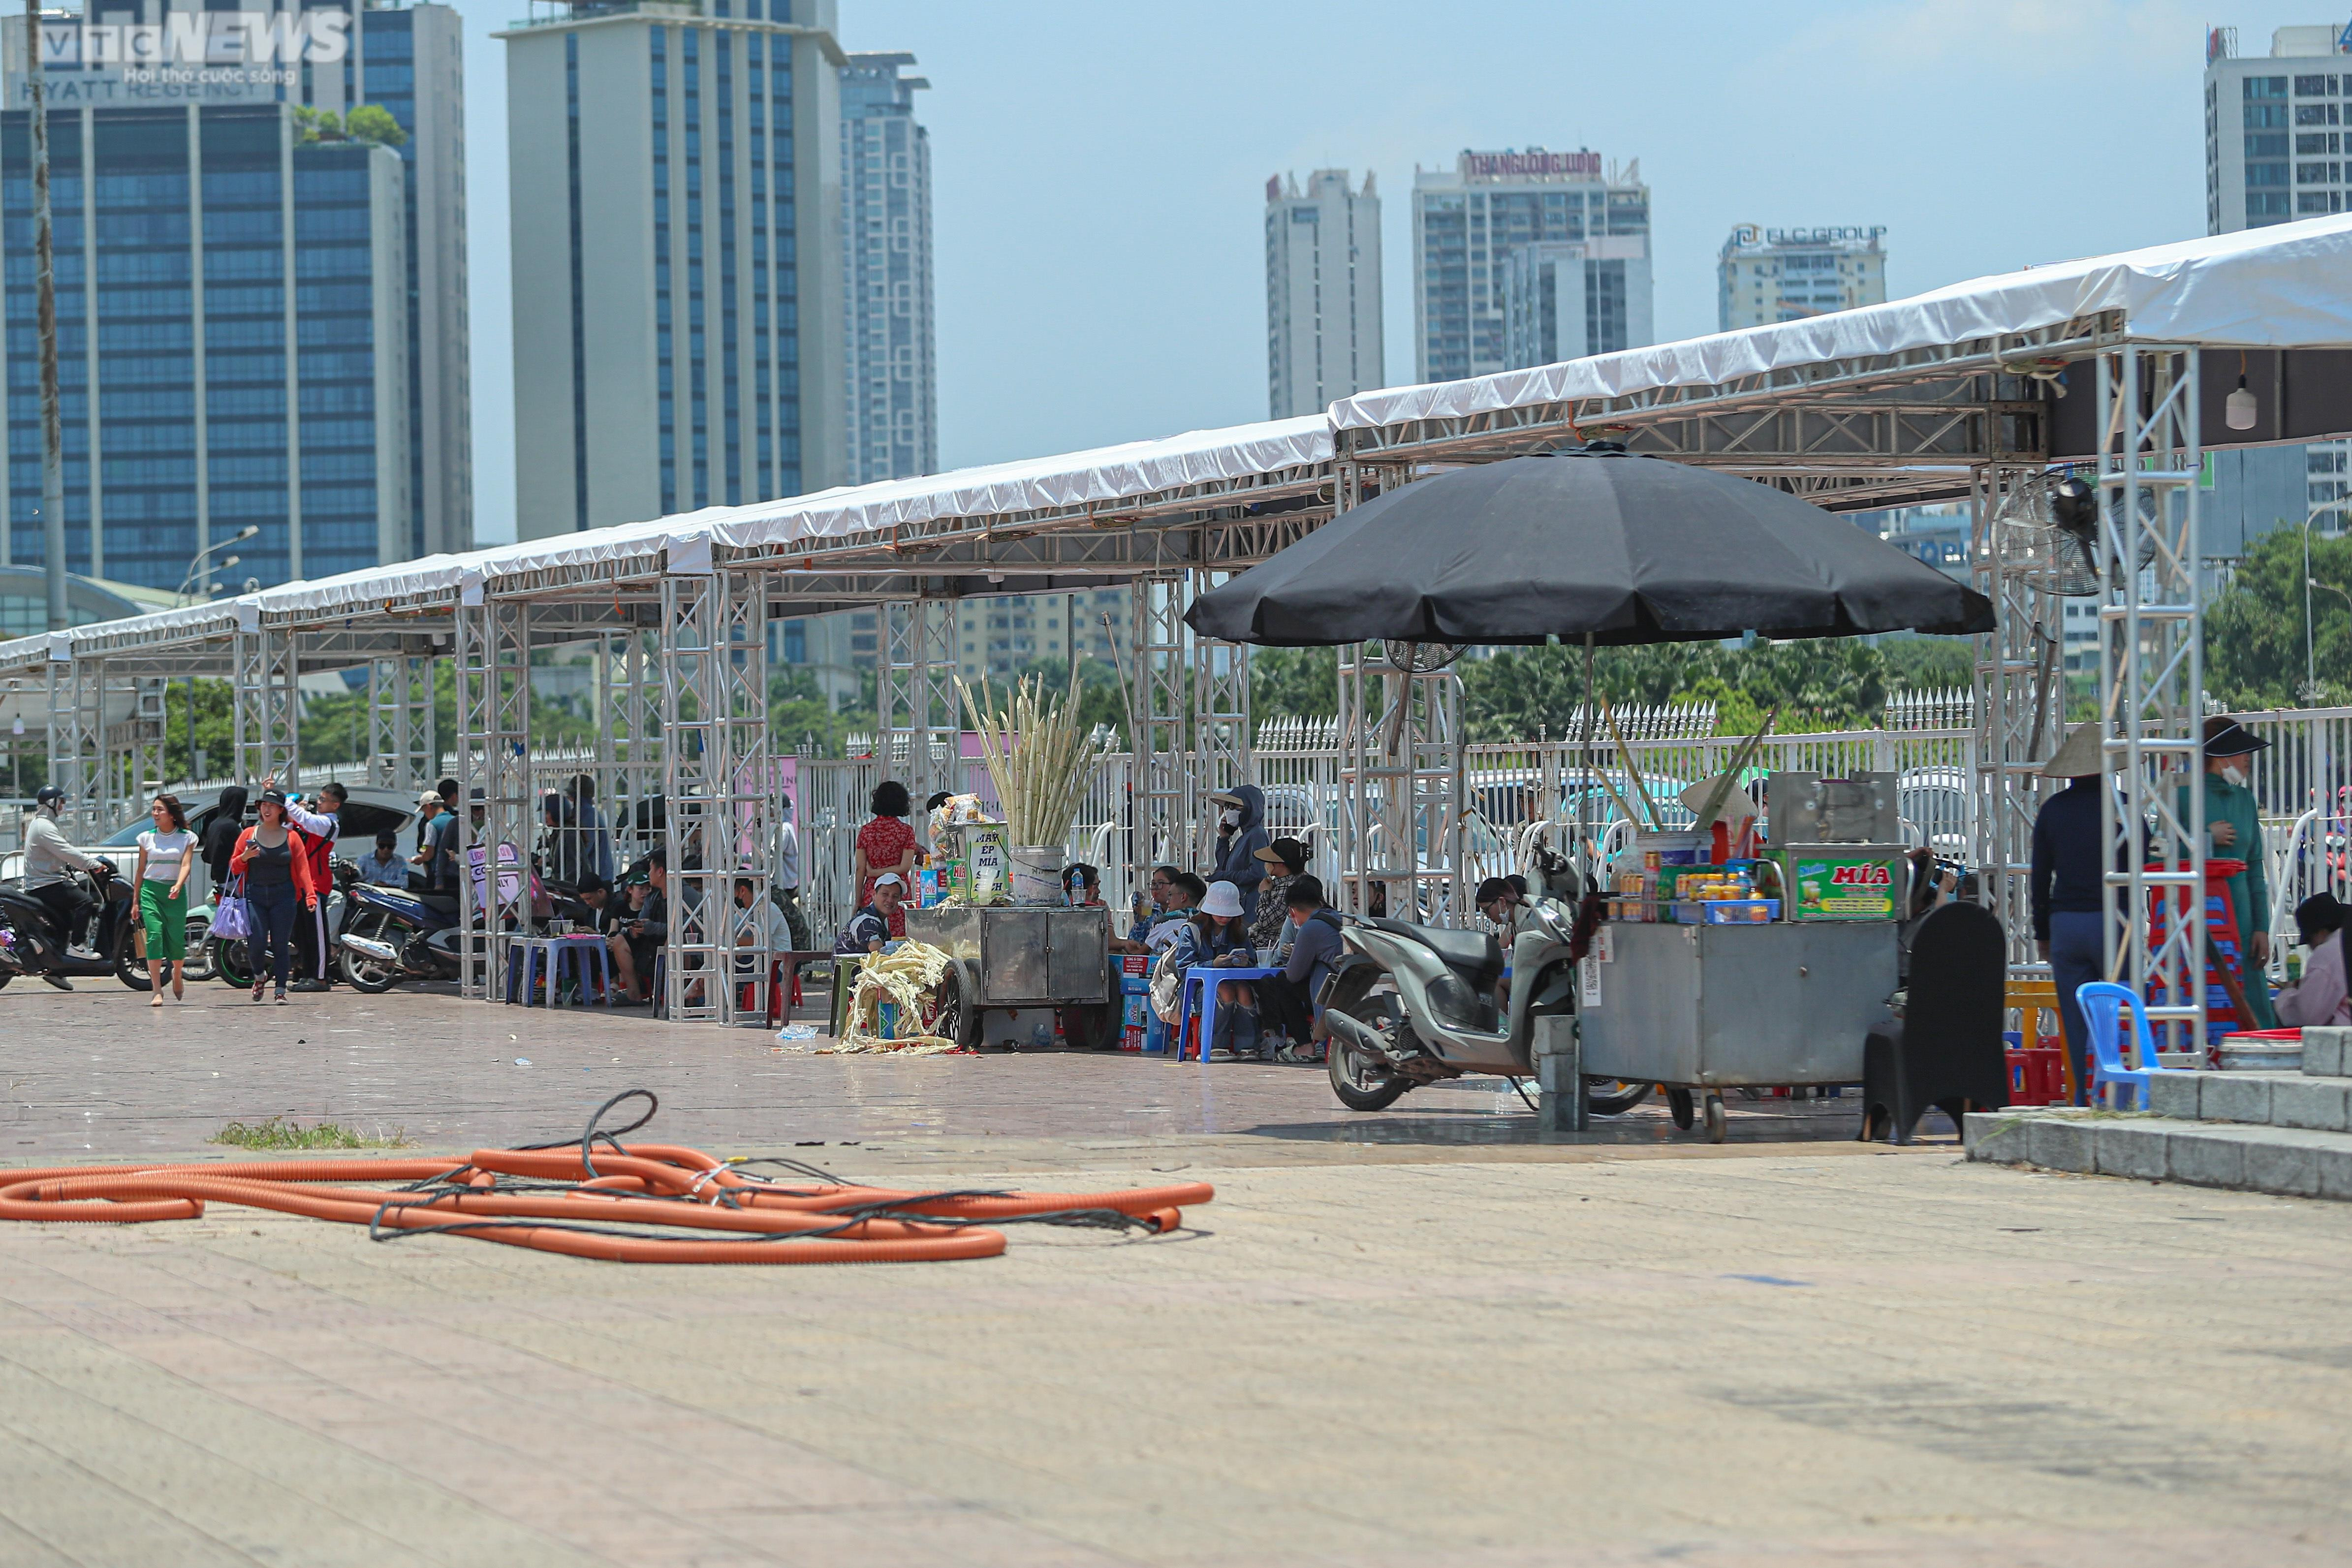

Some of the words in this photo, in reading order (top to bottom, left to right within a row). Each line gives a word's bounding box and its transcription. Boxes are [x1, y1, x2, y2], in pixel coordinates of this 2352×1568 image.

[1813, 225, 1887, 242] GROUP
[976, 832, 999, 843] MÁY
[981, 844, 995, 854] ÉP
[978, 856, 998, 866] MÍA
[953, 864, 966, 878] MÍA
[1831, 863, 1892, 885] MÍA
